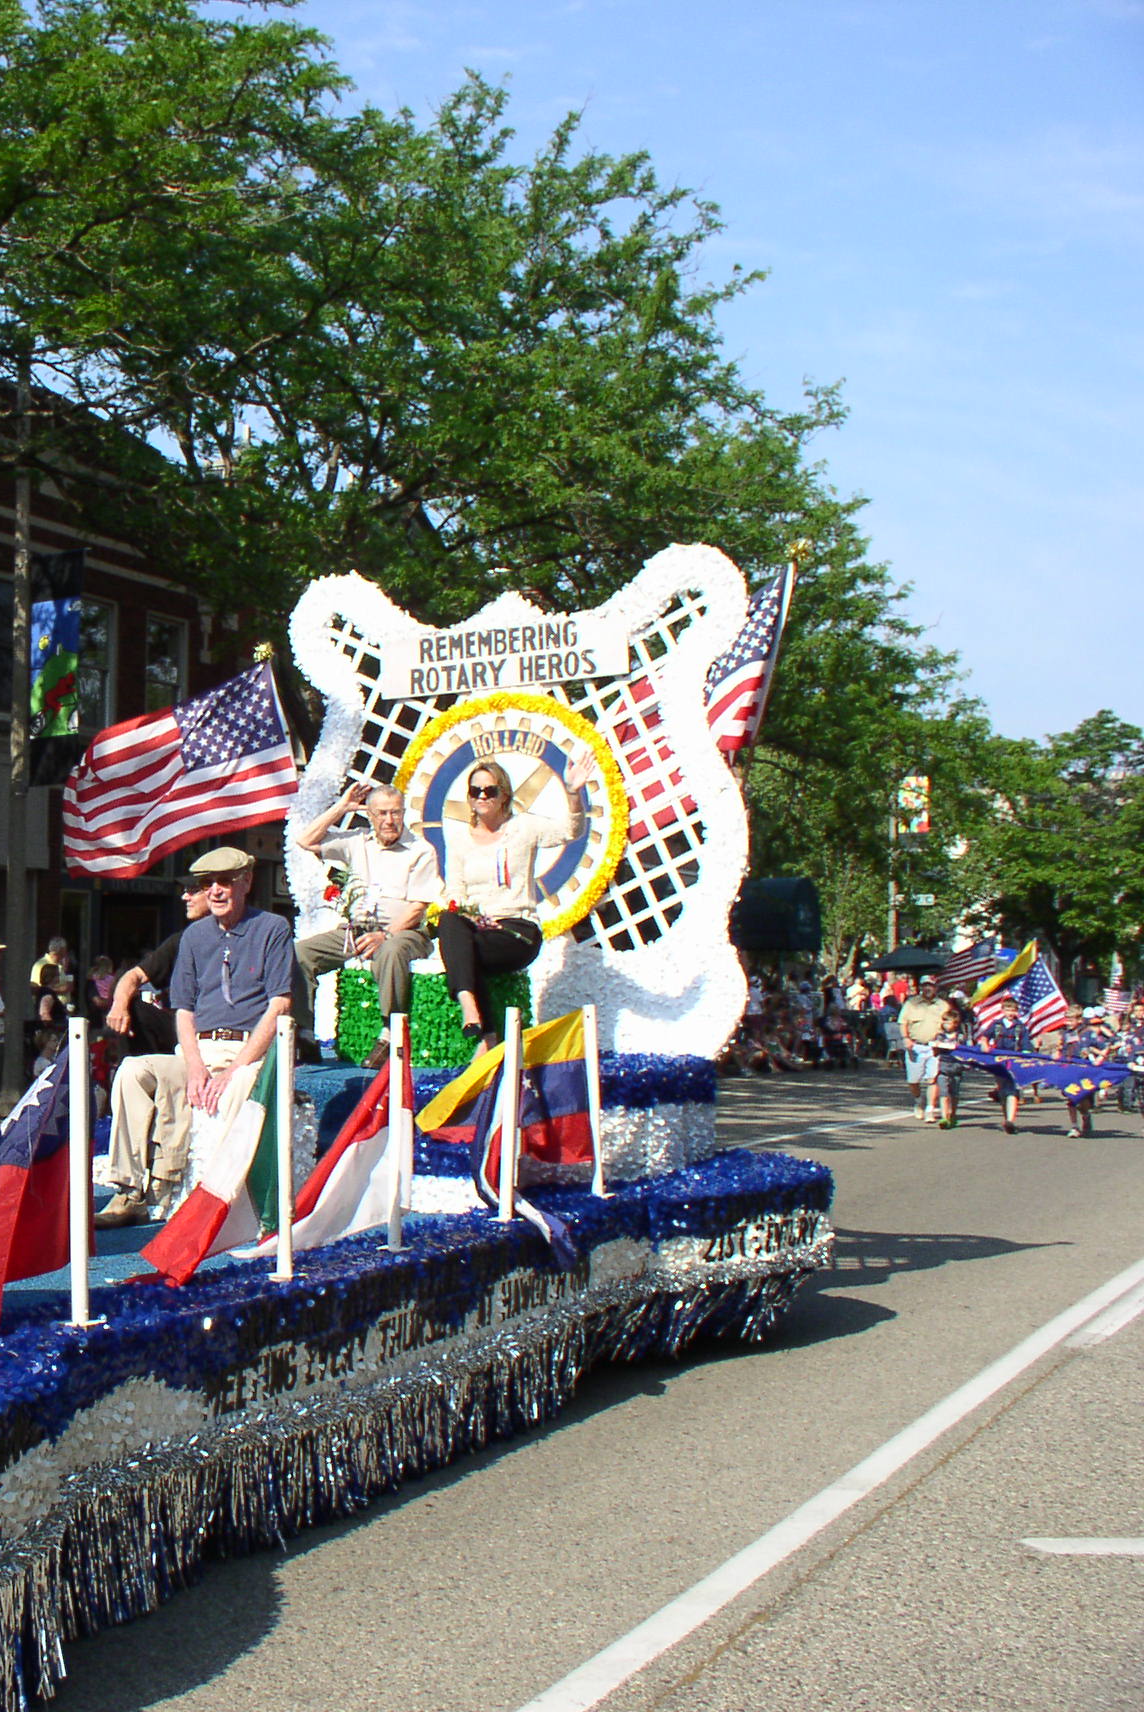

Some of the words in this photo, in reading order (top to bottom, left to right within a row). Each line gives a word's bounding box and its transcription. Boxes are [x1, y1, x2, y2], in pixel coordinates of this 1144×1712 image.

[419, 620, 578, 664] REMEMBERING
[410, 658, 507, 695] ROTARY
[519, 649, 597, 683] HEROS
[470, 730, 546, 758] HOLLAND
